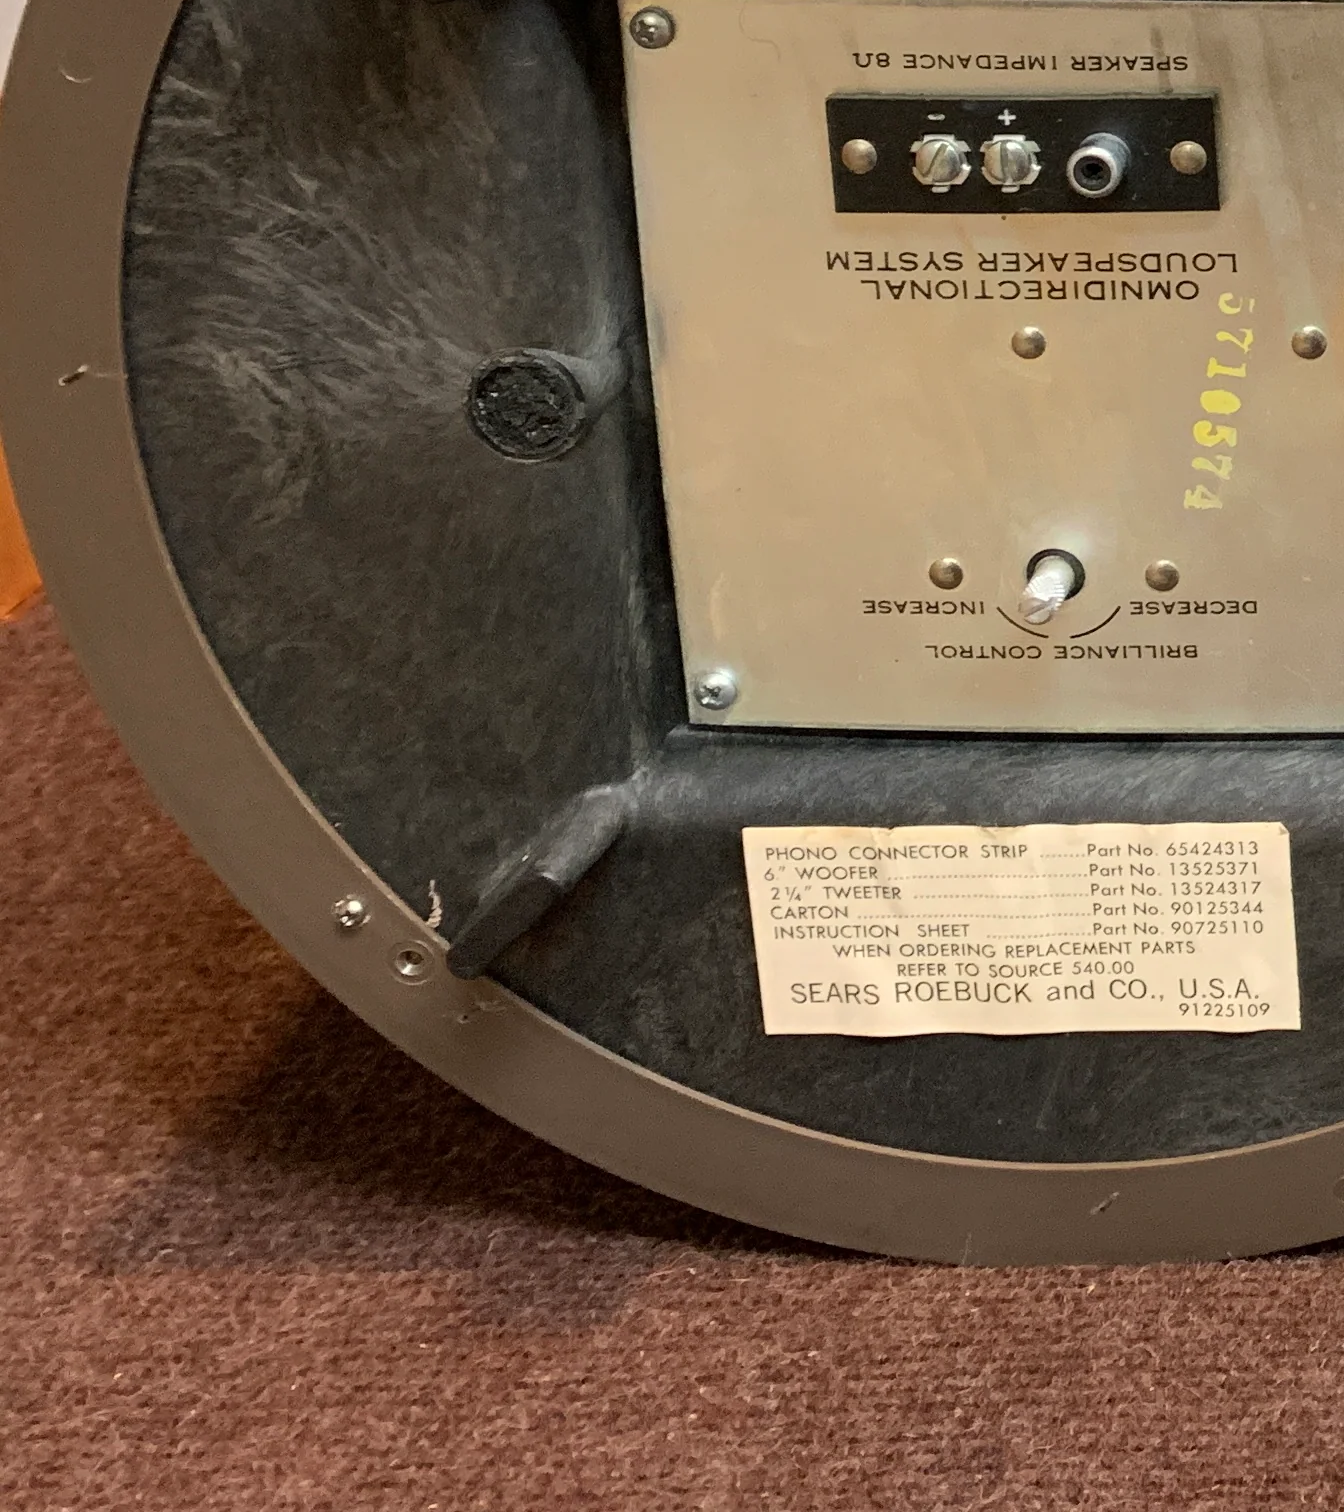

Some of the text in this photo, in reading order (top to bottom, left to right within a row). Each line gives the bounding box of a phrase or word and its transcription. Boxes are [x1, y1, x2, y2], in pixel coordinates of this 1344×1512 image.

[903, 55, 1057, 71] IMPEDANCE
[1070, 55, 1188, 71] SPEAKER
[826, 251, 1237, 272] LOUDSPEAKER SYSTEM
[861, 279, 1199, 300] OMNIDIRECTIONAL
[1184, 292, 1255, 509] 5710574
[862, 600, 984, 614] INCREASE
[1130, 600, 1257, 614] DECREASE
[925, 645, 1197, 658] BRILLIANCE CONTROL
[765, 842, 1258, 861] PHONO CONNECTOR STRIP Part No. 65424313
[796, 866, 878, 880] WOOFER
[1089, 863, 1123, 877] Part
[1130, 863, 1161, 876] No.
[1169, 862, 1258, 876] 13525371
[824, 886, 901, 900] TWEETER
[1091, 883, 1124, 896] Part
[1131, 883, 1163, 896] No.
[1171, 882, 1261, 895] 13524317
[770, 902, 1263, 920] CARTON Part No. 90125344
[774, 921, 1263, 939] INSTRUCTION SHEET Part No. 90725110
[833, 941, 1195, 957] WHEN ORDERING REPLACEMENT PARTS
[897, 961, 1134, 977] REFER TO SOURCE 540.00
[791, 978, 1260, 1005] SEARS ROEBUCK and CO., U.S.A.
[1179, 1002, 1270, 1018] 91225109
